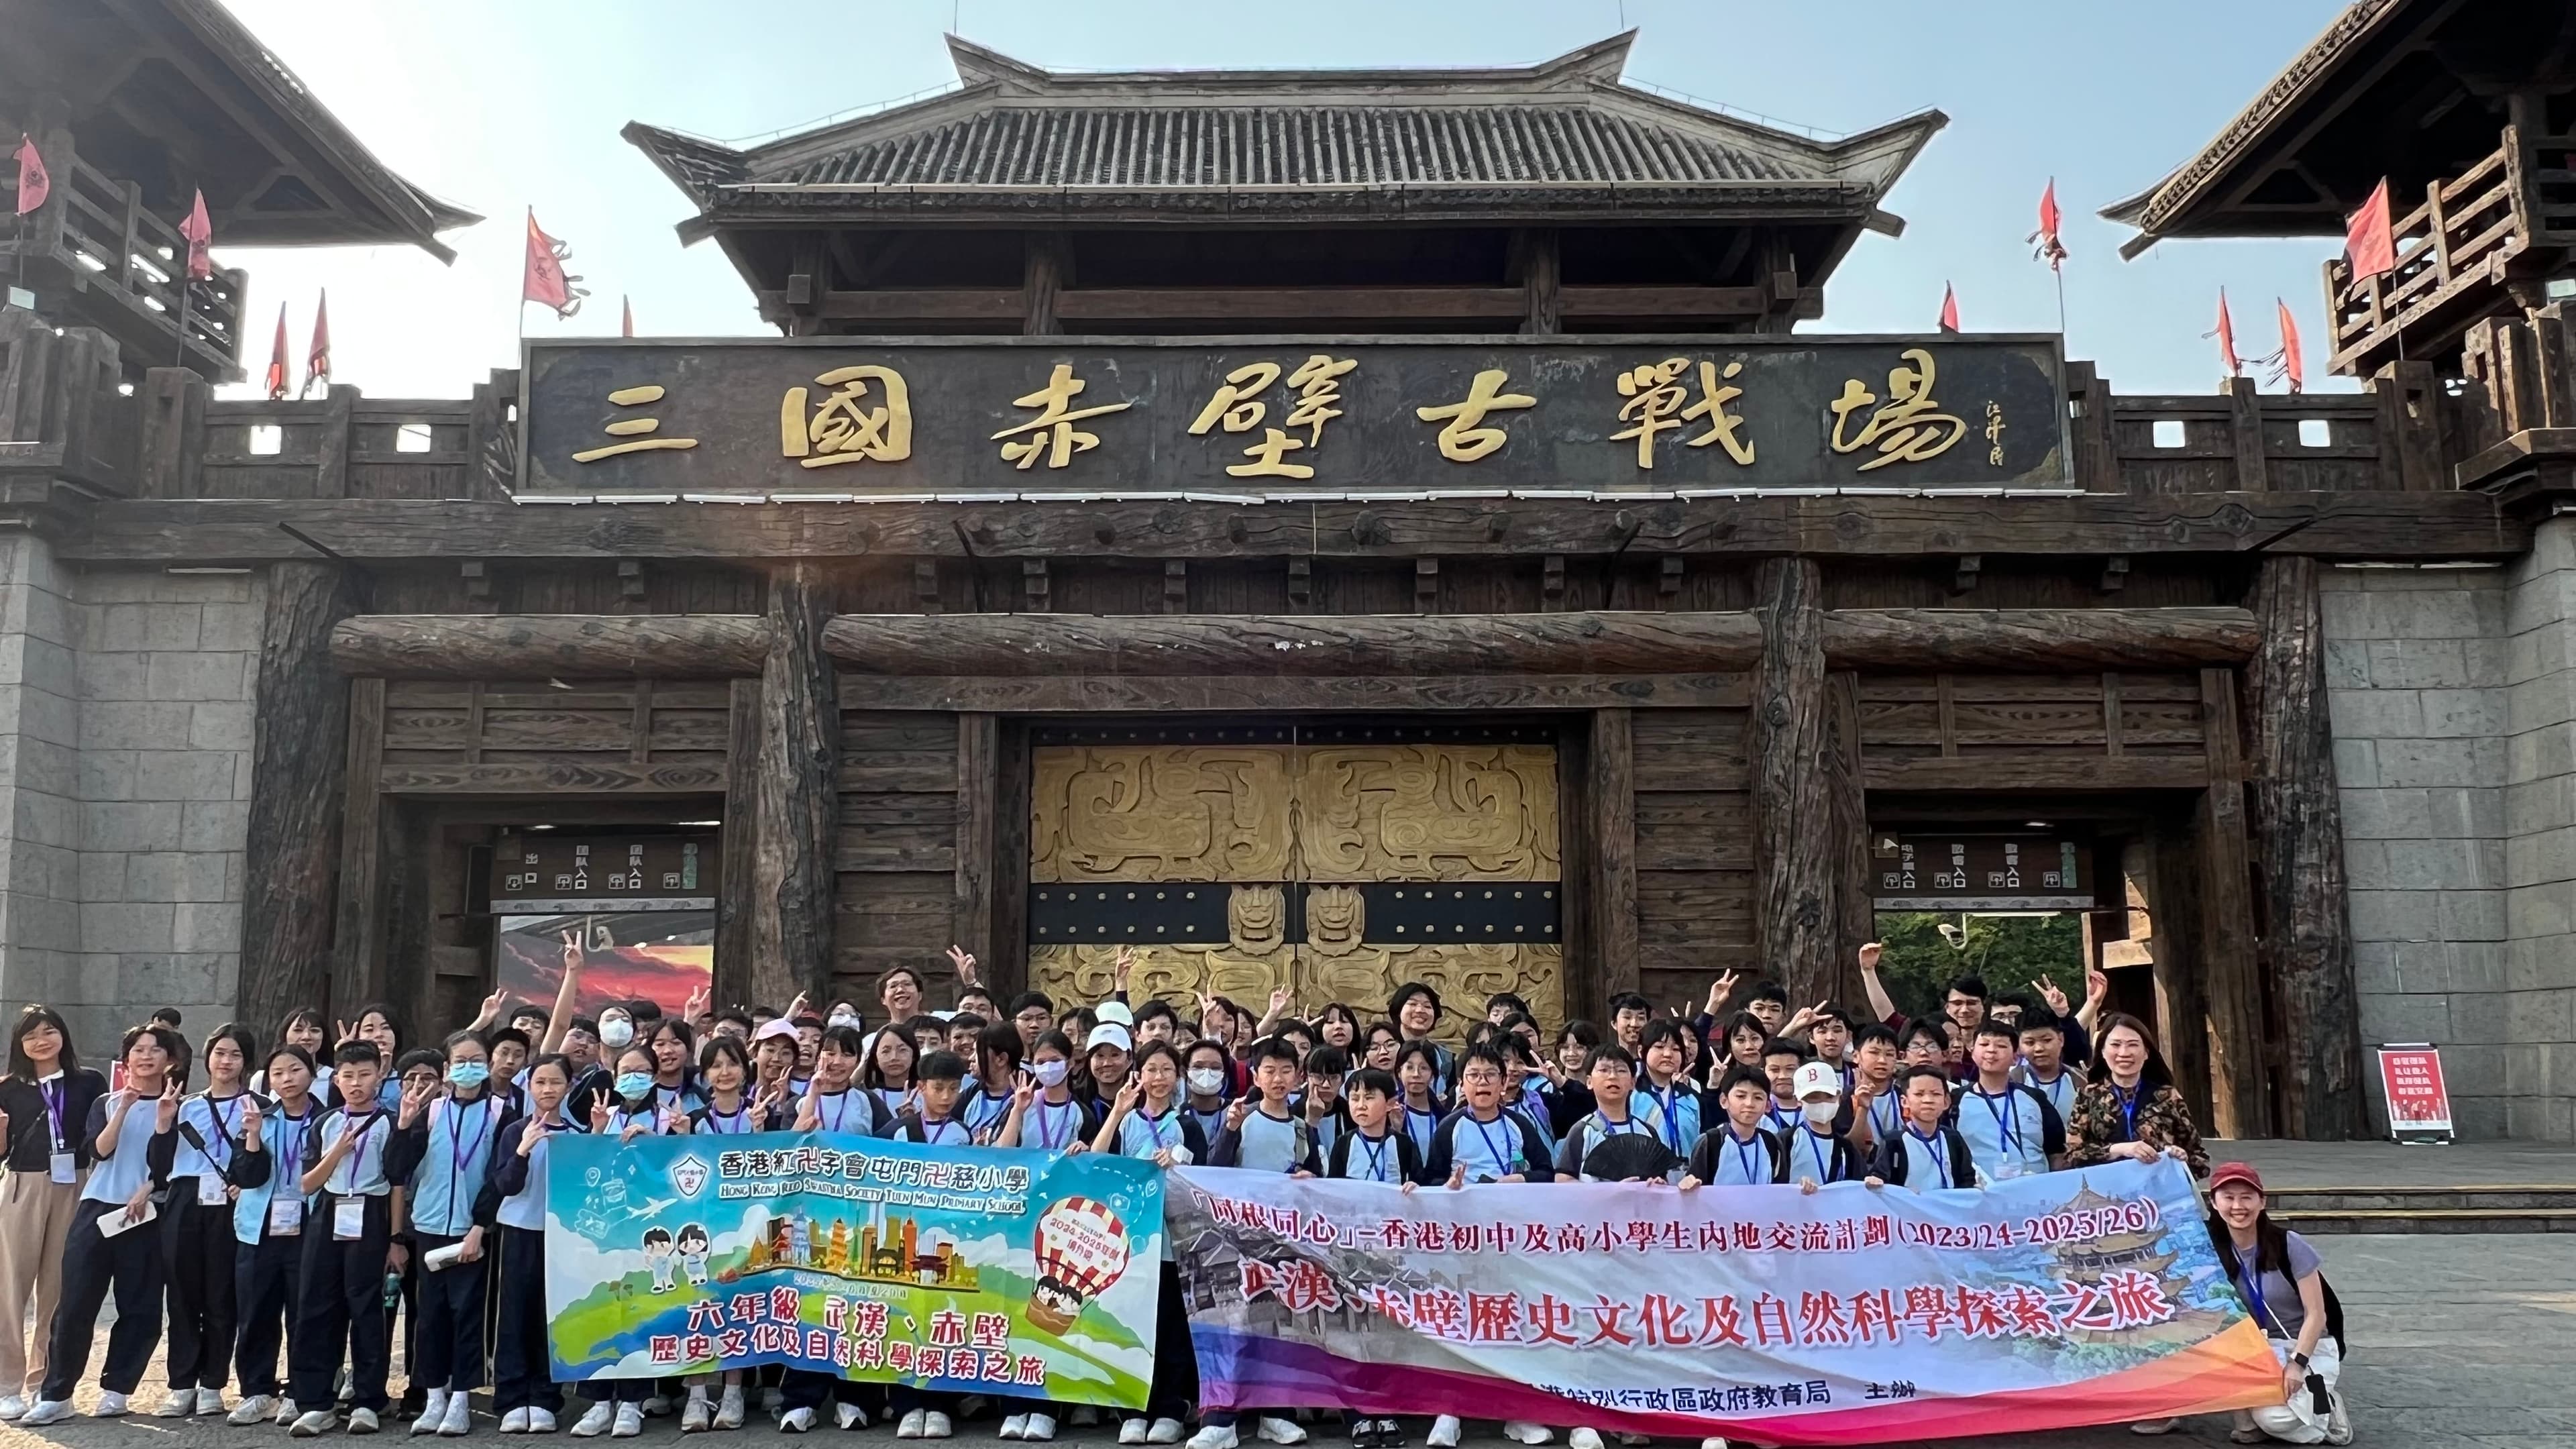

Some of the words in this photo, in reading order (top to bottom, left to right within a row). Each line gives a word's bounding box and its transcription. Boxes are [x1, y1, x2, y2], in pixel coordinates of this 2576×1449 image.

[574, 349, 1968, 480] 三國赤壁古戰場
[1807, 1069, 1818, 1082] B
[720, 1184, 749, 1197] HONG
[689, 1287, 800, 1330] 六年級
